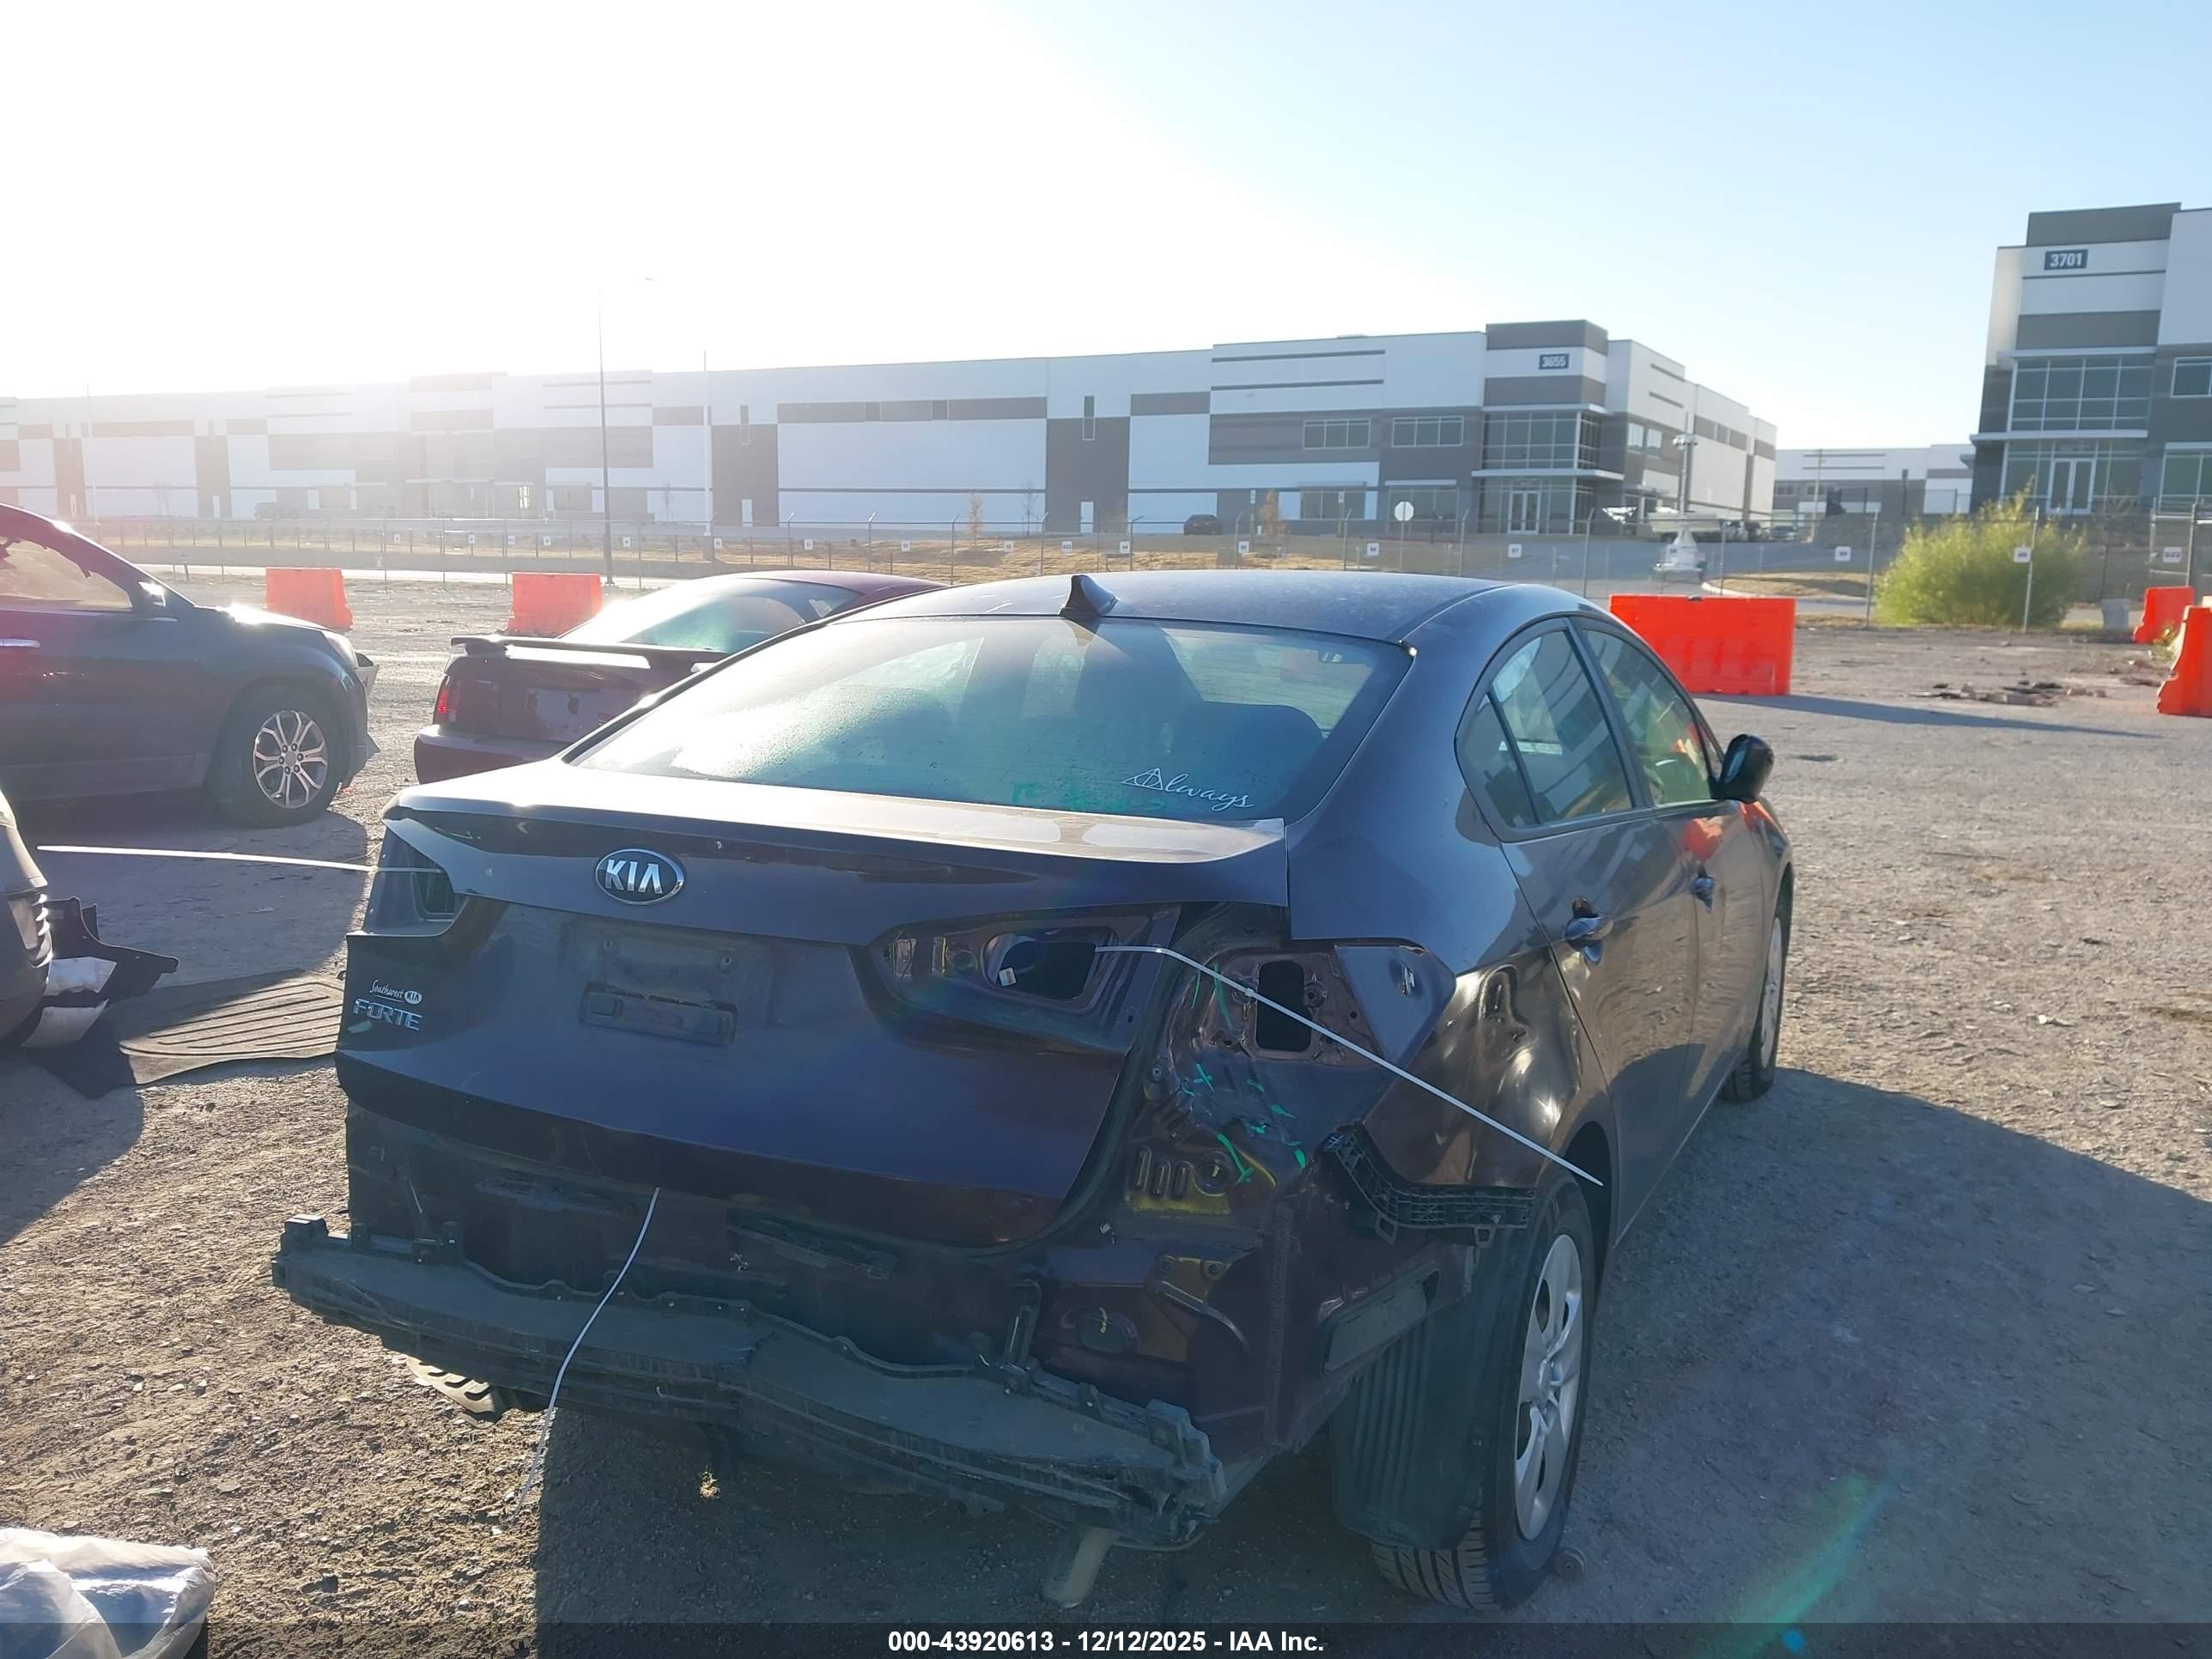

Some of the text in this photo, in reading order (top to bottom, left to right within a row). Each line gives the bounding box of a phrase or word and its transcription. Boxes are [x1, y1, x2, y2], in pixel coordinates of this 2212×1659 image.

[2050, 252, 2083, 268] 3701
[1121, 768, 1254, 811] Always
[605, 859, 663, 894] KIA
[369, 979, 404, 998] Southwest
[353, 999, 423, 1030] FORTE
